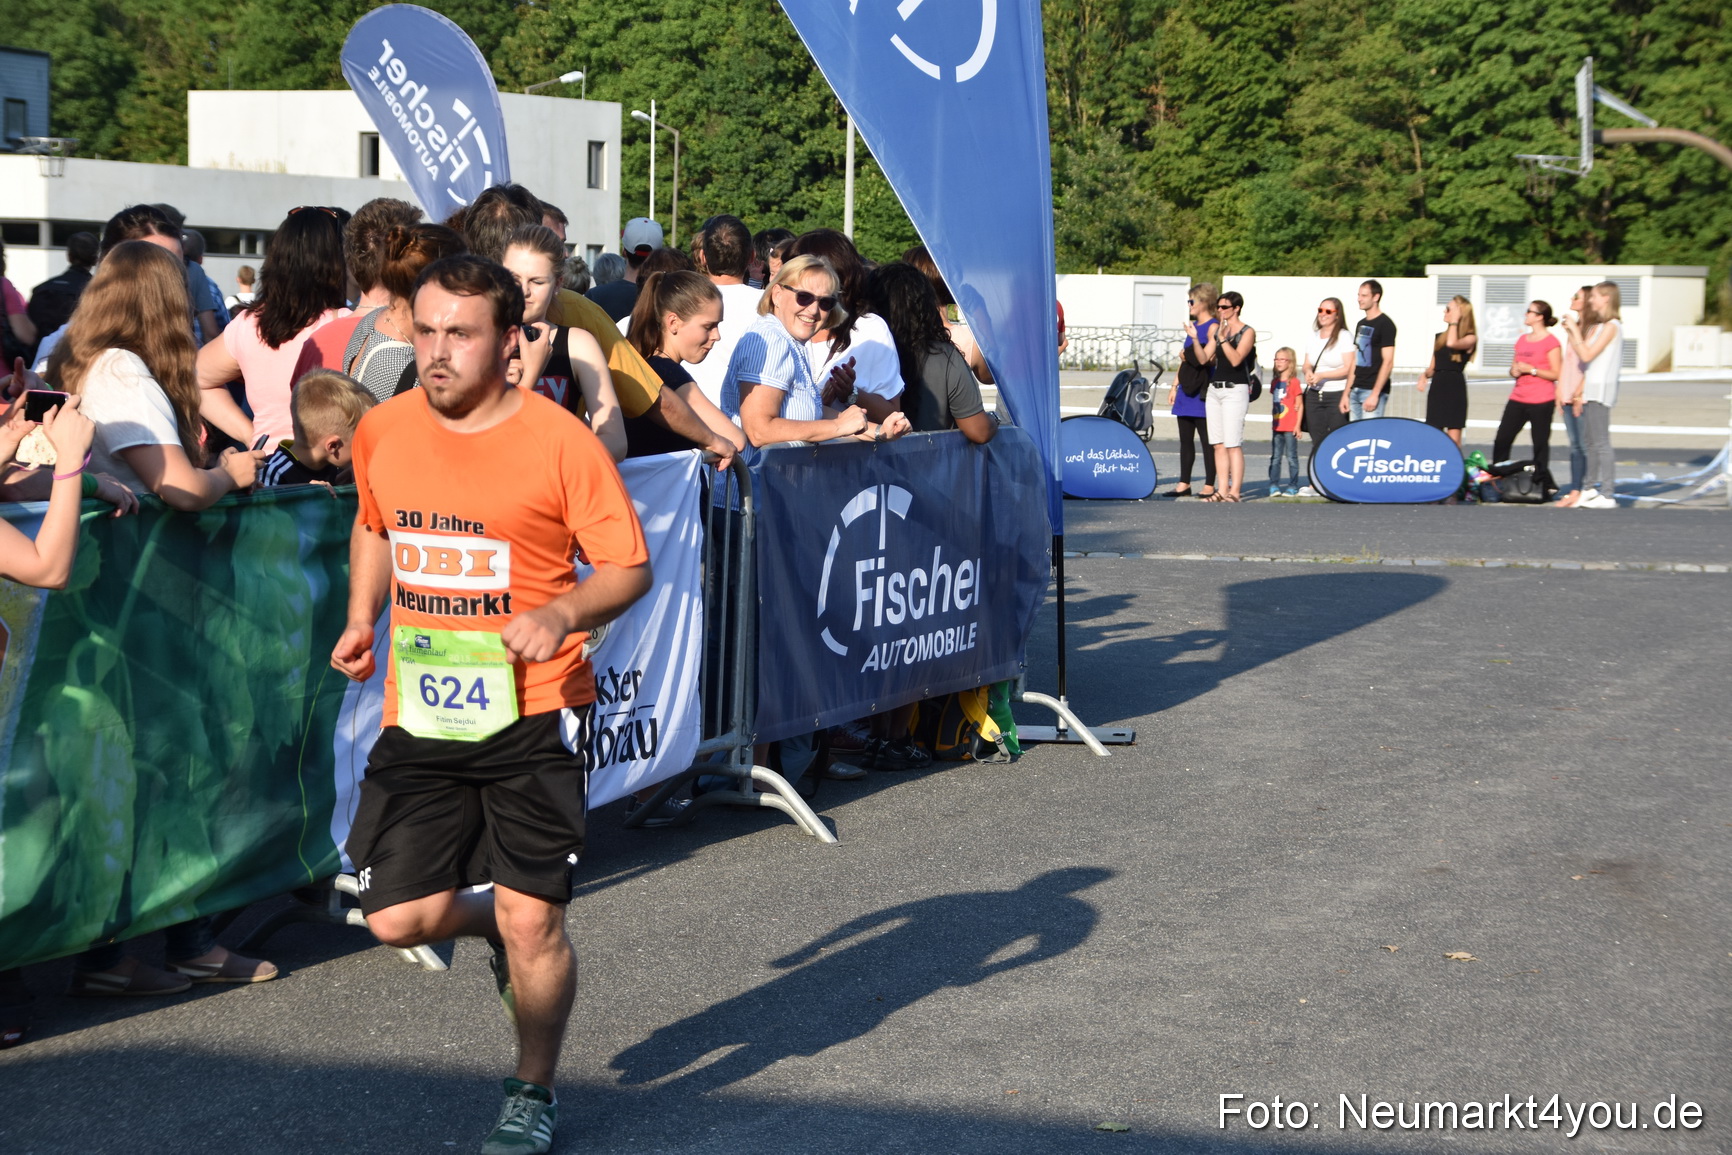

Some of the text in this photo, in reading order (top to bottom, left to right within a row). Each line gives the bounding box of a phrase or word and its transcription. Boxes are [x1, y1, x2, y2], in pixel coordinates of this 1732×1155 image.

[1065, 450, 1085, 463] und
[1087, 448, 1104, 460] das
[1092, 462, 1139, 478] fährt mit!
[1352, 454, 1447, 474] Fischer
[1362, 475, 1441, 484] AUTOMOBILE
[395, 509, 485, 535] 30 Jahre
[395, 541, 498, 577] OBI
[395, 581, 513, 617] Neumarkt
[860, 621, 978, 673] AUTOMOBILE
[419, 672, 491, 711] 624
[583, 707, 658, 773] bräu
